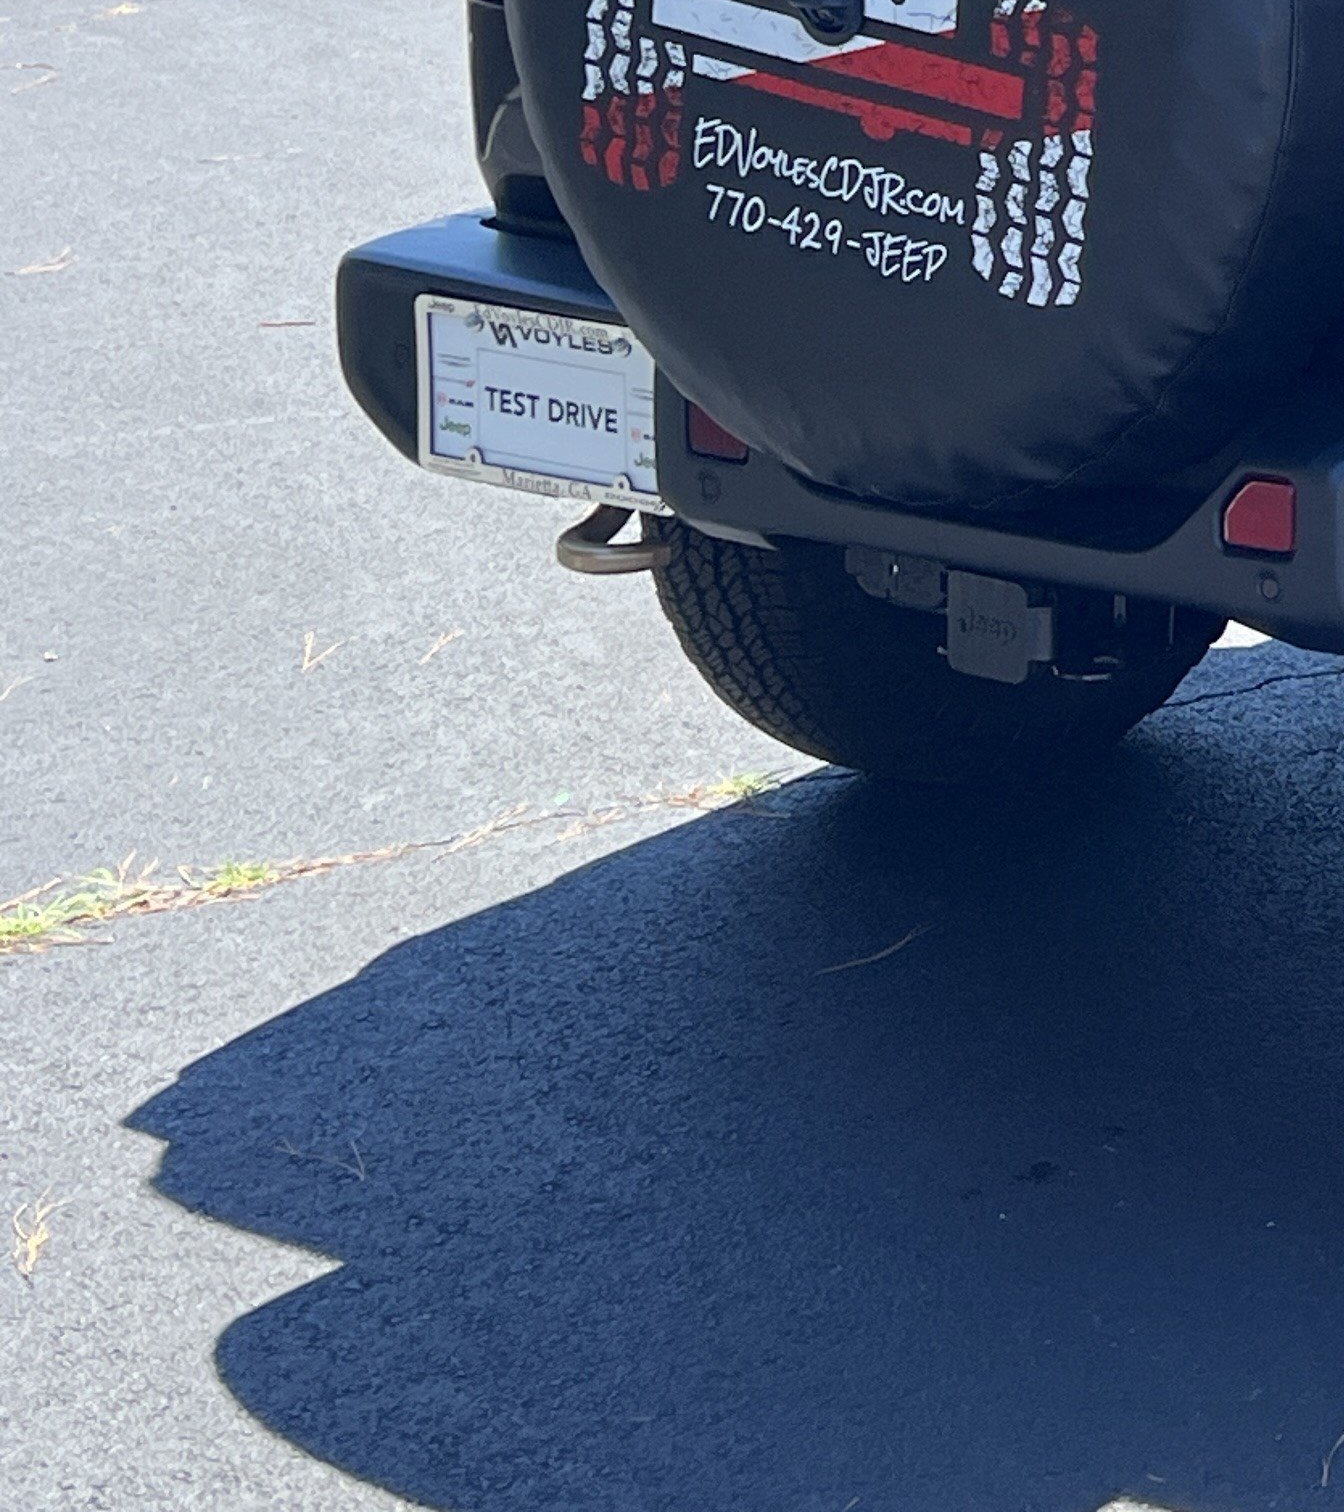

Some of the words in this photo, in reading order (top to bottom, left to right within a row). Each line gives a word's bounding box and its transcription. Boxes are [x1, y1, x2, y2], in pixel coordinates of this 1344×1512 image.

[706, 183, 948, 282] 770-429-JEEP
[439, 416, 472, 437] Jeep
[485, 386, 540, 419] TEST
[548, 398, 618, 434] DRIVE
